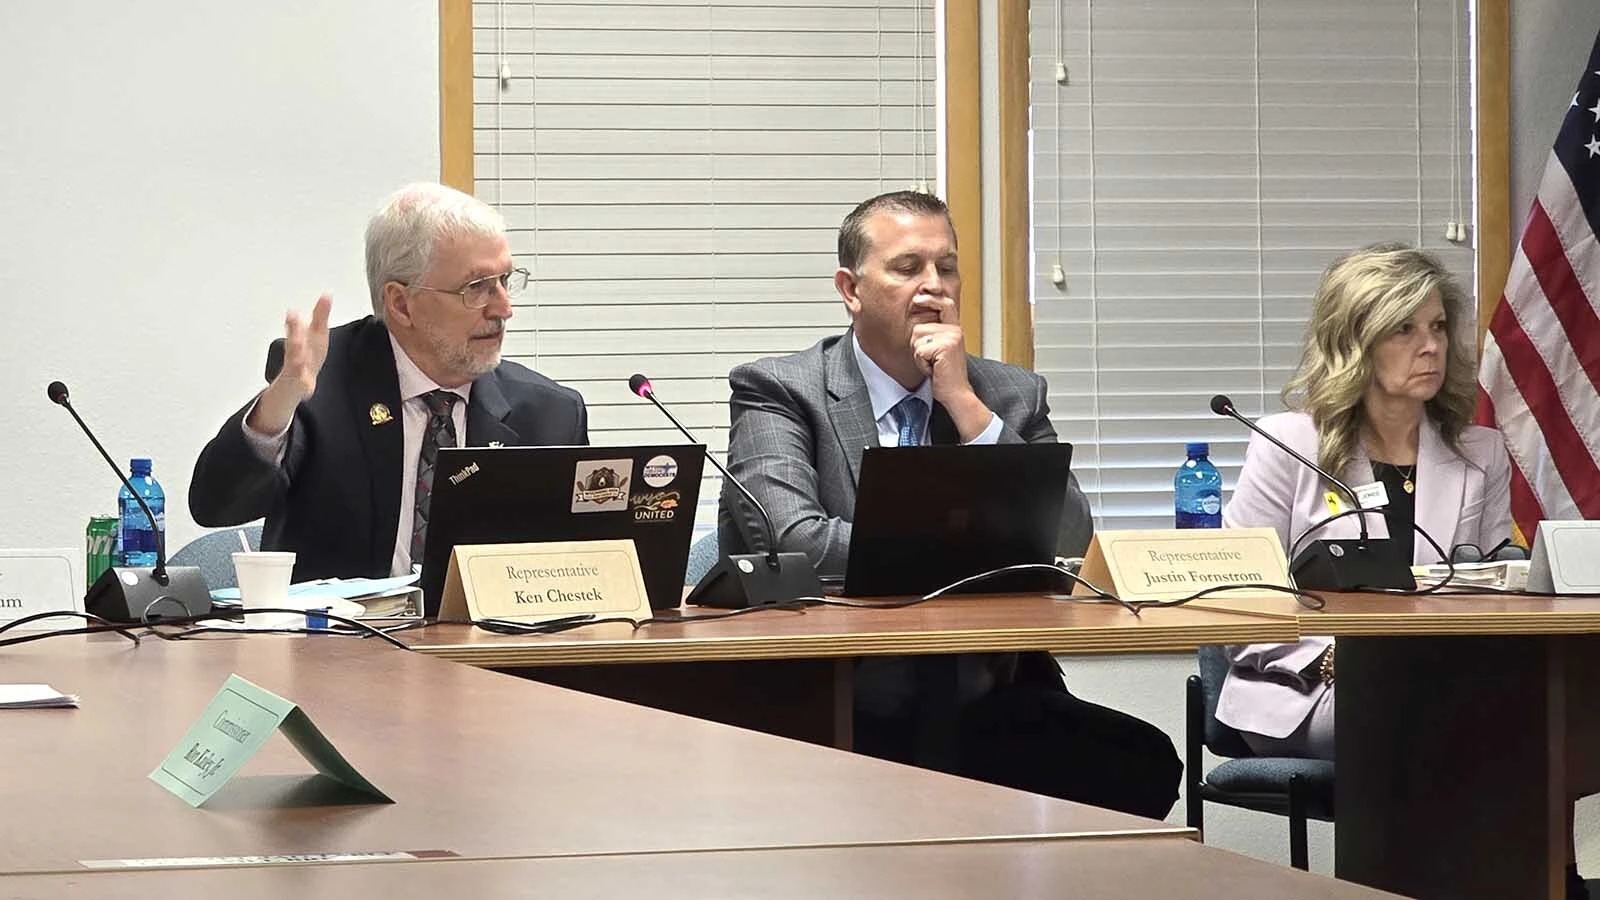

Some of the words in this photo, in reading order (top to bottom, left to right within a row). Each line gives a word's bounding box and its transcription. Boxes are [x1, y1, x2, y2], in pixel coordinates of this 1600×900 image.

[449, 462, 480, 486] ThinkPad
[634, 509, 675, 520] UNITED
[1148, 548, 1243, 565] Representative
[506, 563, 600, 583] Representative
[1143, 571, 1187, 587] Justin
[1188, 570, 1263, 582] Fornstrom
[514, 590, 543, 604] Ken
[546, 588, 603, 603] Chestek
